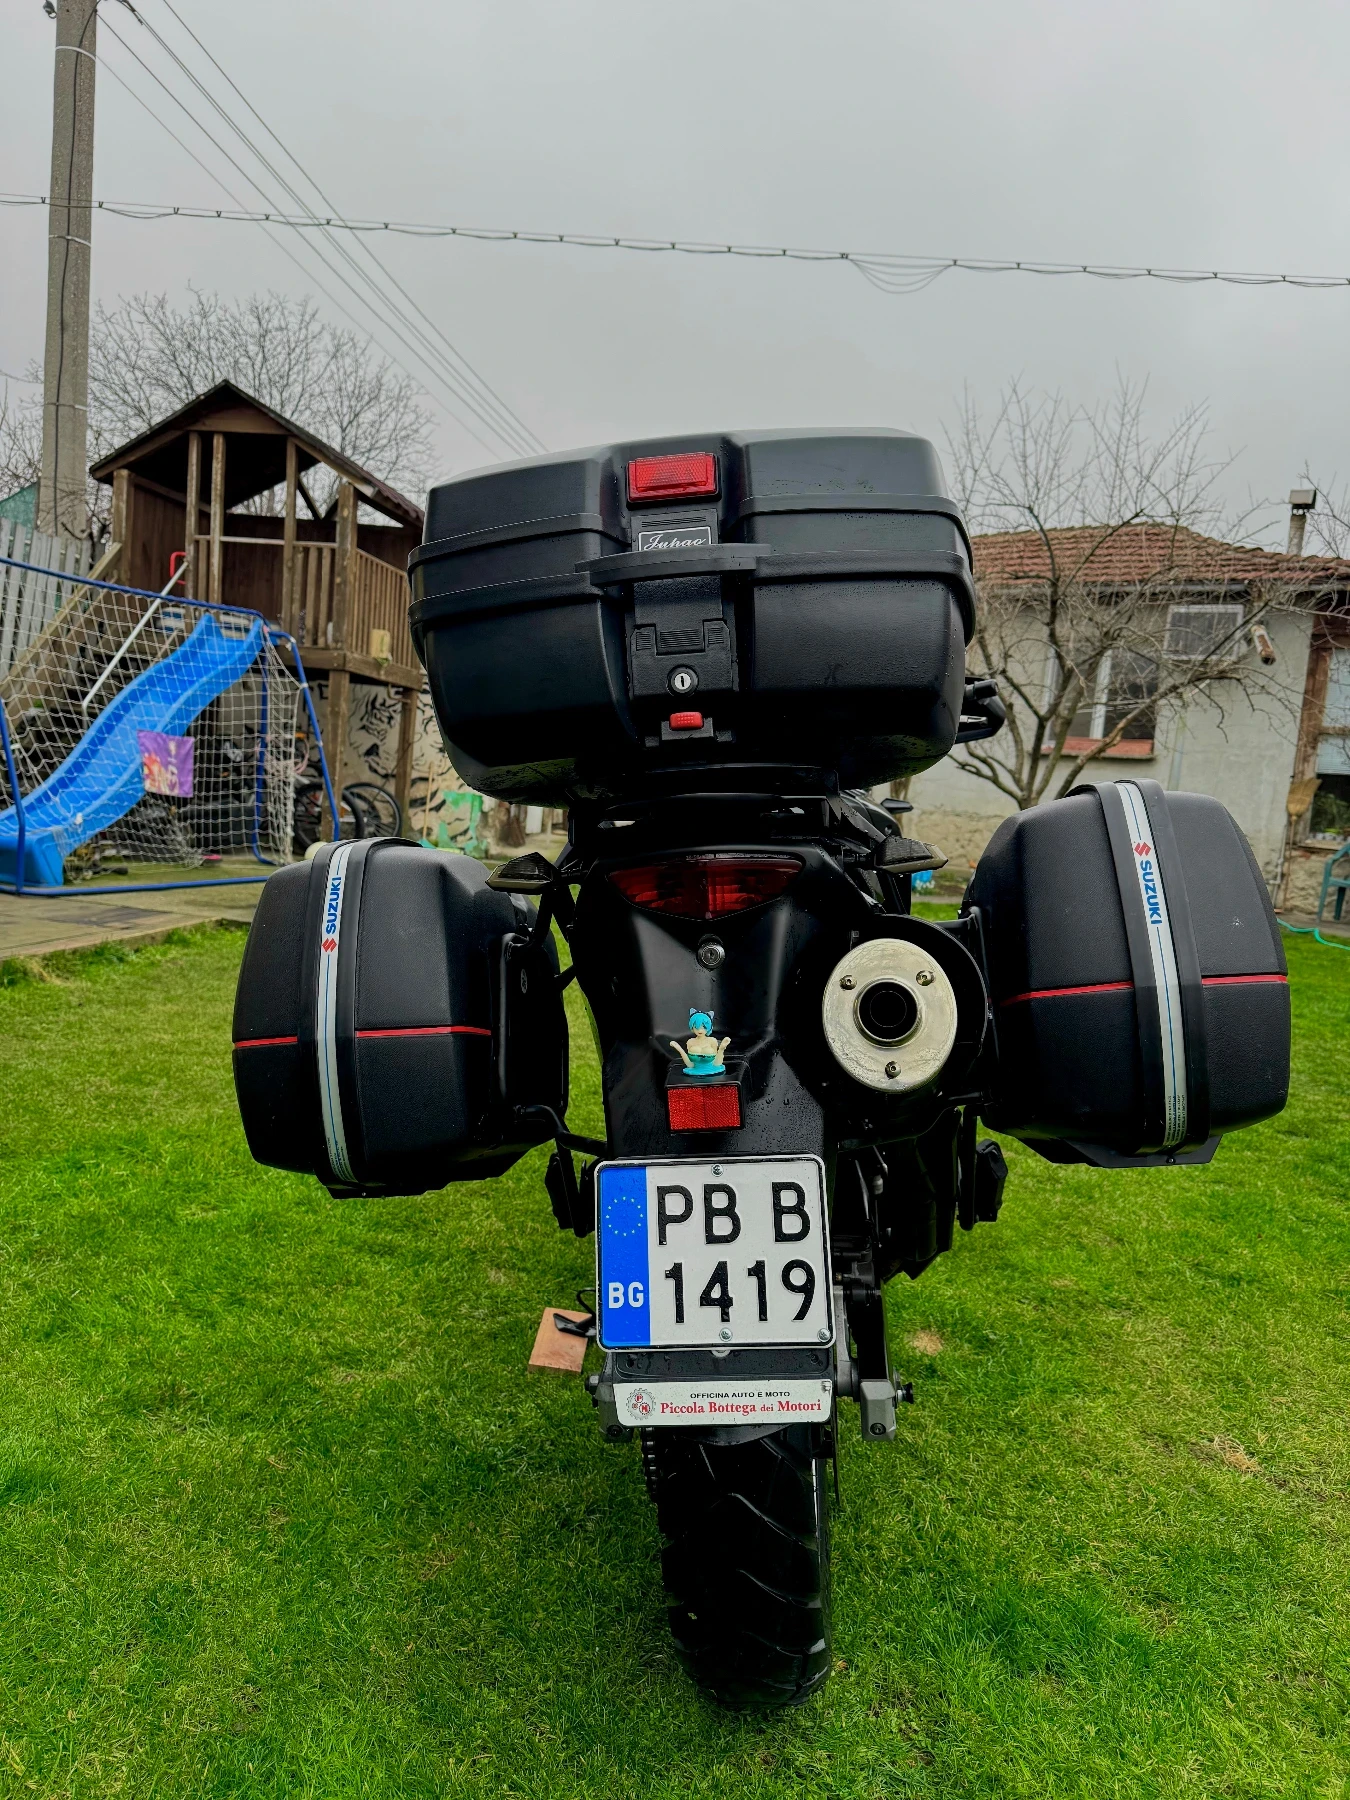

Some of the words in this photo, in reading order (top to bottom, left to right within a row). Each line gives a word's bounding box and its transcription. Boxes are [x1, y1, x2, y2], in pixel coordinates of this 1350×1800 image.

[325, 876, 342, 935] SUZUKI
[1139, 859, 1163, 926] SUZUKI
[656, 1183, 742, 1246] PB
[771, 1181, 811, 1243] B
[608, 1281, 645, 1309] BG
[664, 1258, 816, 1324] 1419
[660, 1401, 705, 1414] Piccola
[708, 1401, 757, 1417] Bottega
[760, 1403, 774, 1412] dei
[777, 1399, 822, 1412] Motori
